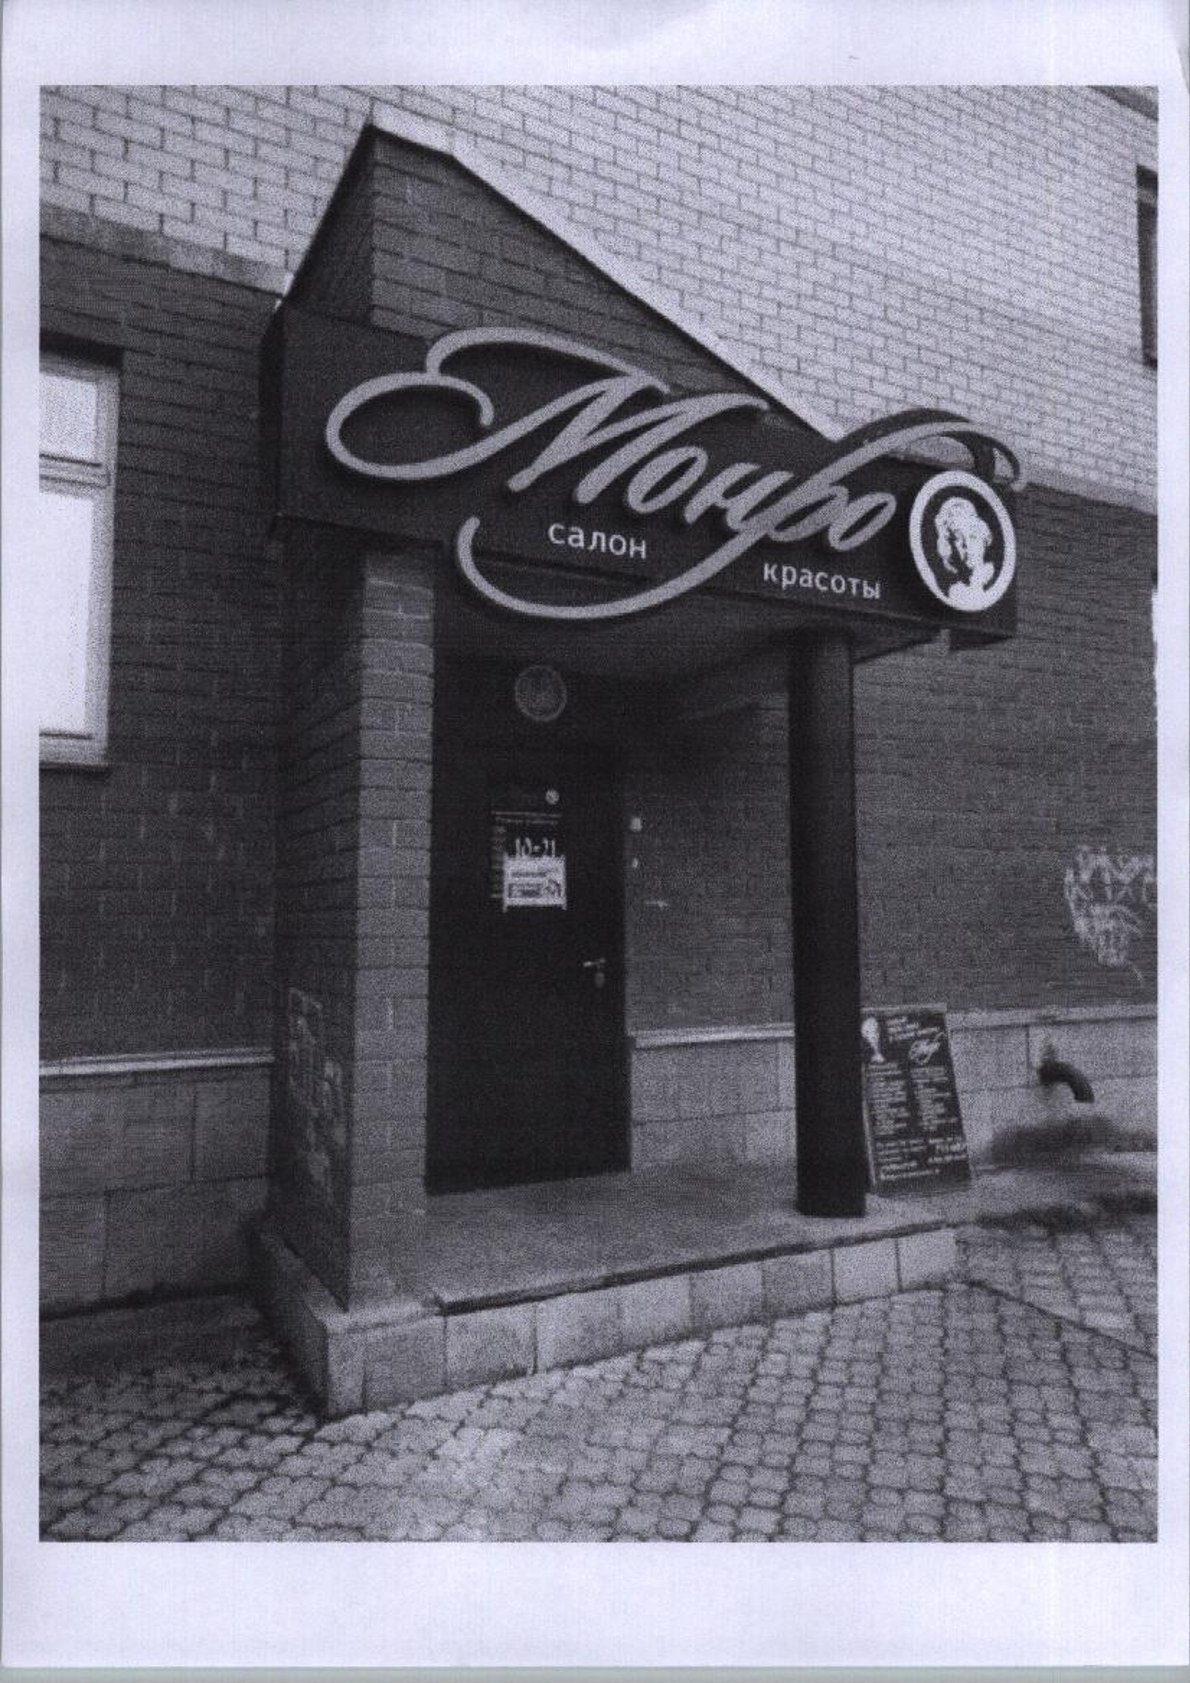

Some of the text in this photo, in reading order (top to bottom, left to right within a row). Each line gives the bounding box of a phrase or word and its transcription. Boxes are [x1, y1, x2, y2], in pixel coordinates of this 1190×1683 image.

[325, 327, 1022, 620] Монро
[547, 521, 882, 600] салон красоты
